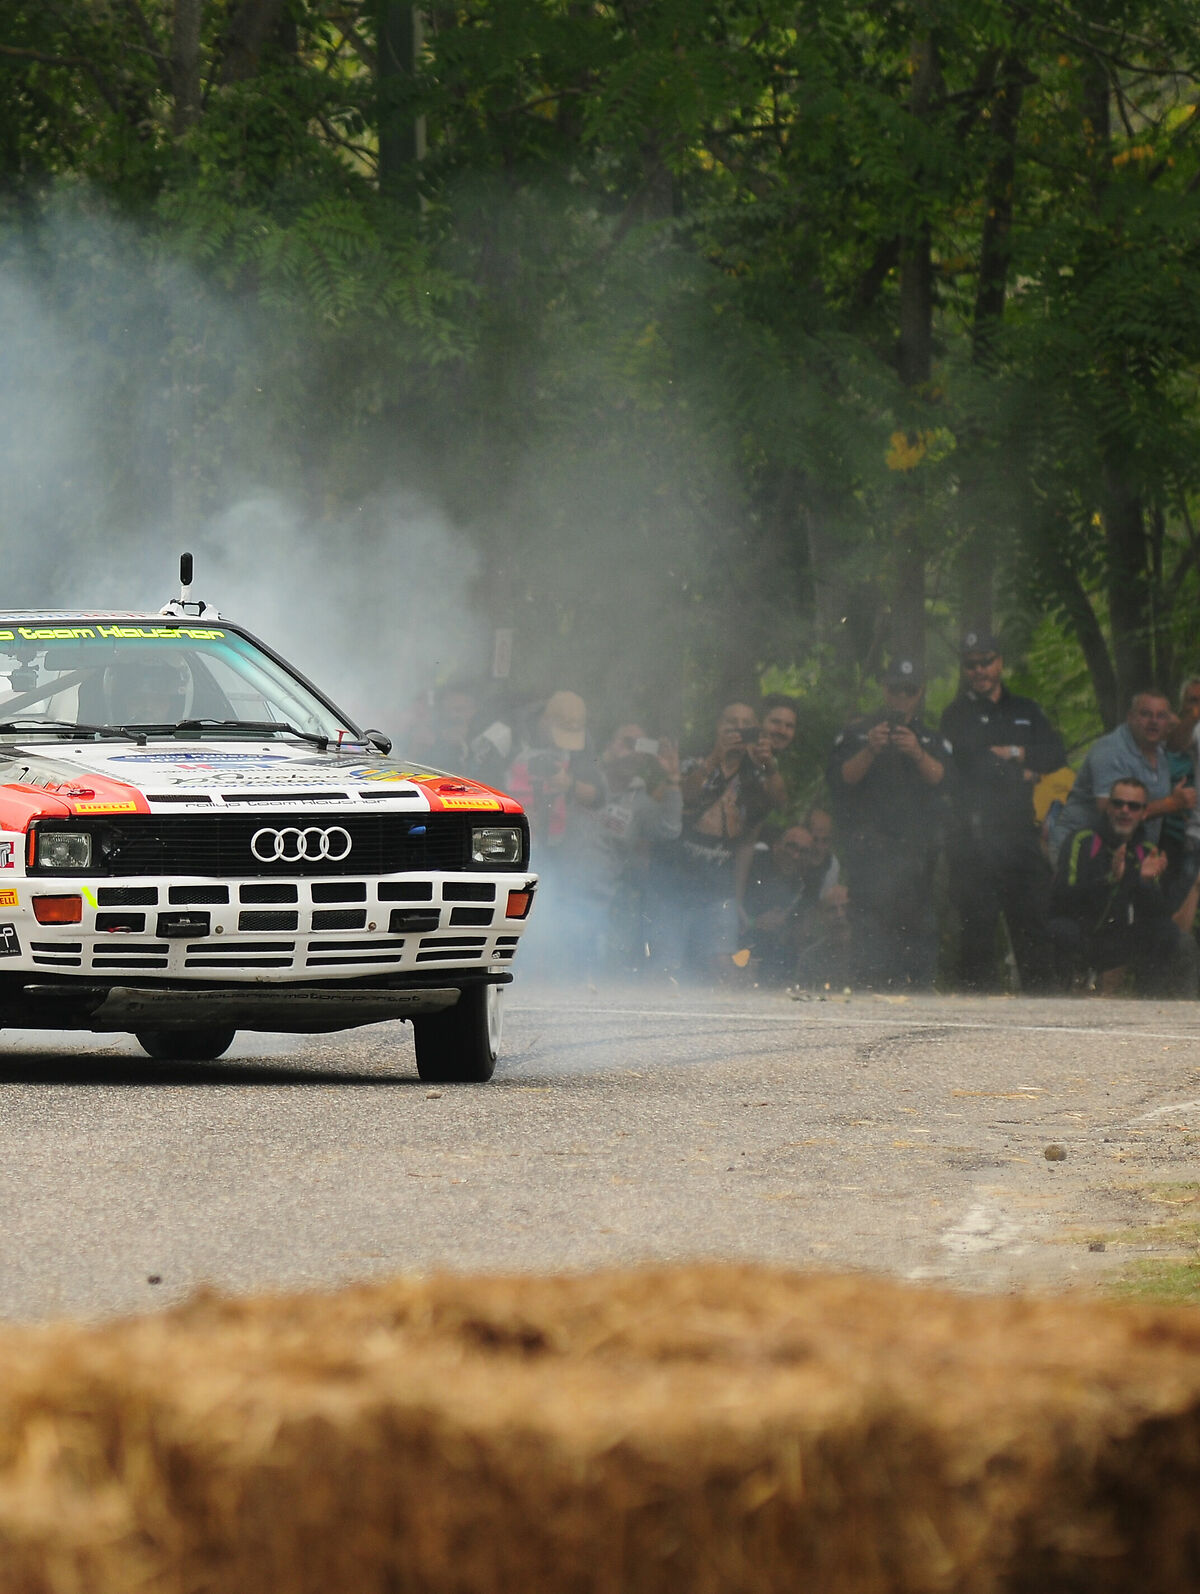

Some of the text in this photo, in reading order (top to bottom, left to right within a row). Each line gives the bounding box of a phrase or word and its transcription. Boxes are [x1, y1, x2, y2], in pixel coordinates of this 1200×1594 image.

[18, 627, 96, 640] team
[96, 625, 225, 640] klausner
[80, 802, 130, 811] PIRELLI
[445, 799, 493, 807] PIRELLI
